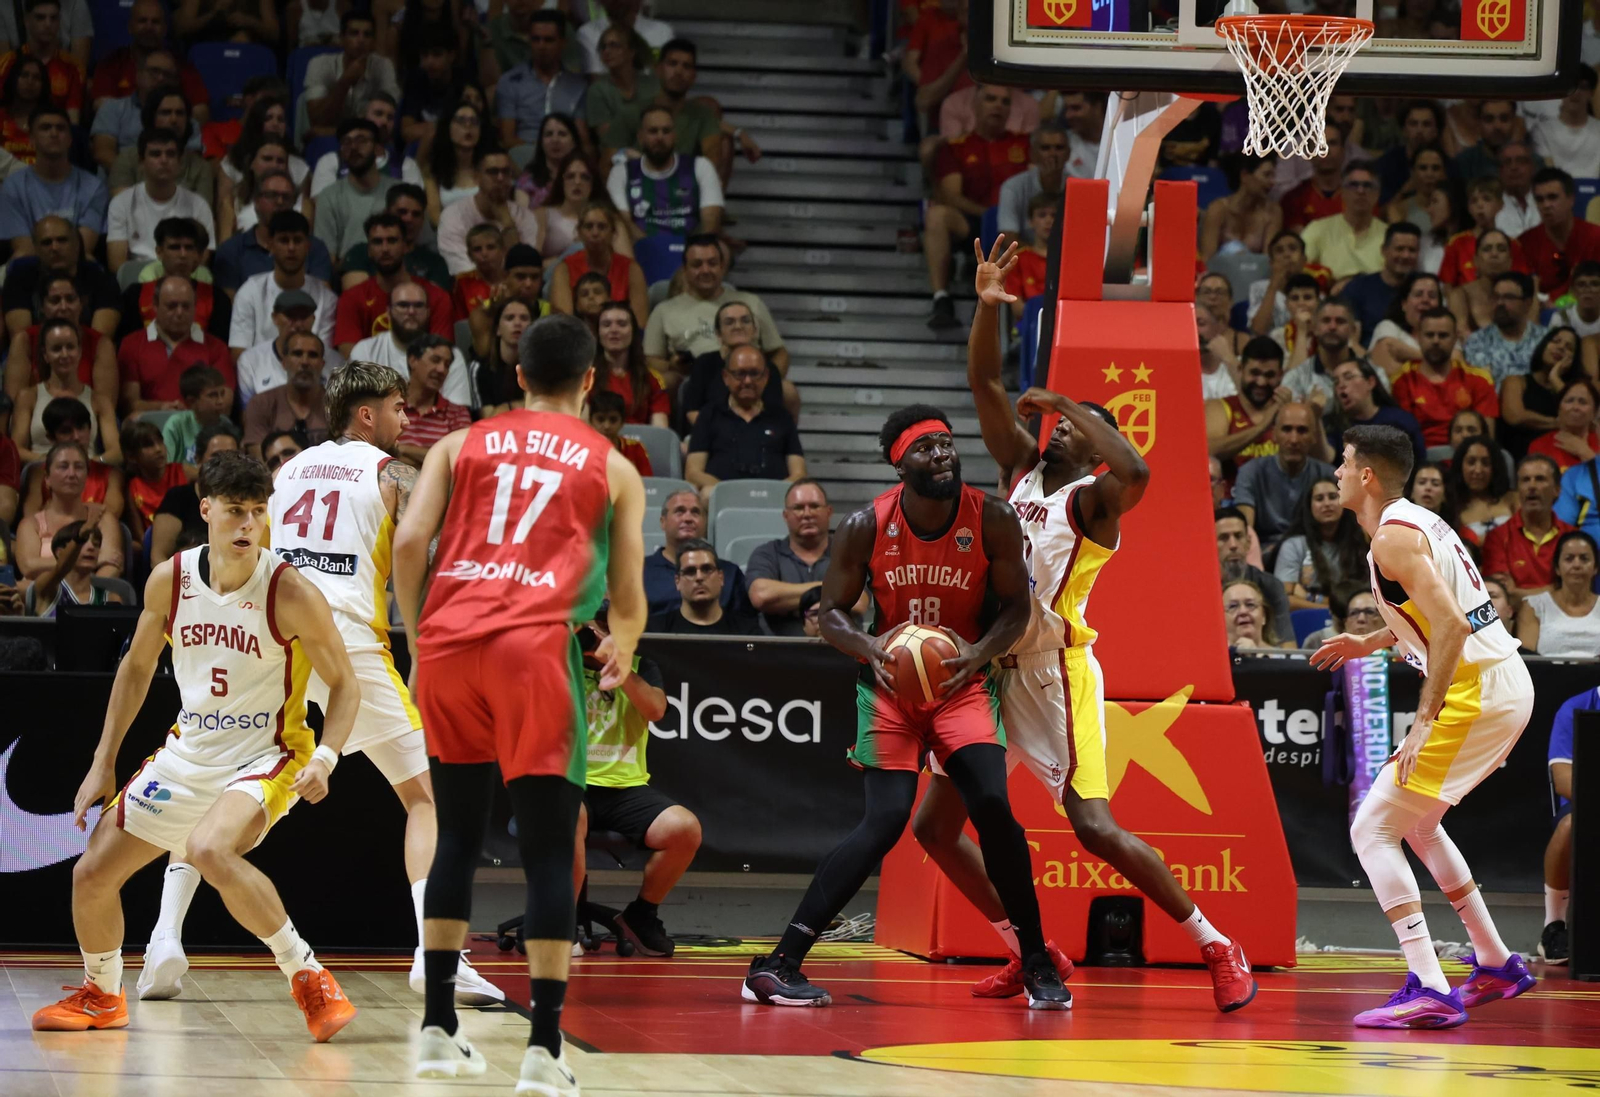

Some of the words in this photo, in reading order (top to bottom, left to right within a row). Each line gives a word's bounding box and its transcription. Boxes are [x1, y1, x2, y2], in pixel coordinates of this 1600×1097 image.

[1133, 394, 1152, 402] FEB
[485, 430, 519, 455] DA
[525, 430, 590, 471] SILVA
[288, 466, 297, 480] J.
[282, 488, 341, 541] 41
[485, 462, 564, 545] 17
[884, 564, 973, 591] PORTUGAL
[1454, 543, 1482, 592] 6
[908, 596, 941, 627] 88
[180, 623, 263, 660] ESPAÑA
[210, 667, 229, 697] 5
[180, 708, 270, 731] endesa
[648, 682, 822, 744] desa
[1351, 675, 1362, 747] BALONCESTO
[1265, 748, 1321, 768] despi
